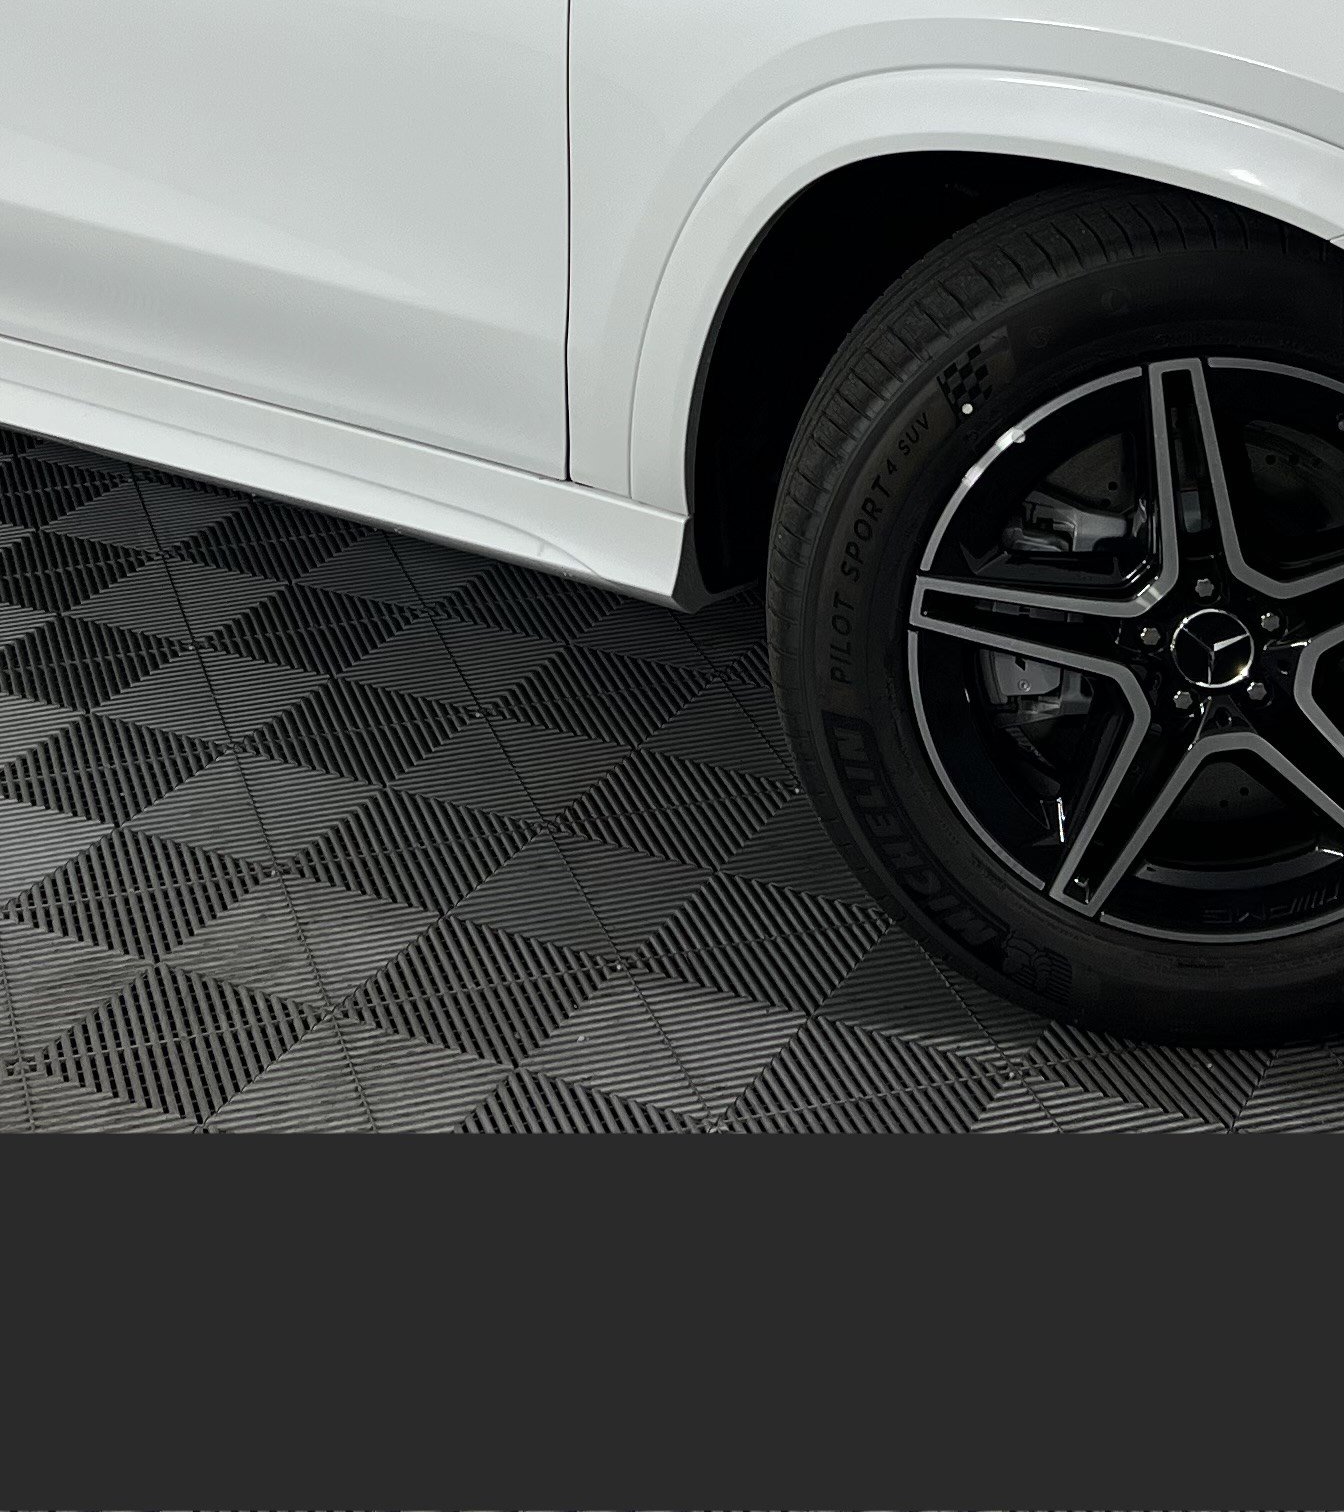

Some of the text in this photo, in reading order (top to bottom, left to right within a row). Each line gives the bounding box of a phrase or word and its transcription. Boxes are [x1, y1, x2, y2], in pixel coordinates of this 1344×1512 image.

[829, 411, 930, 685] PILOT SPORT 4 SUV
